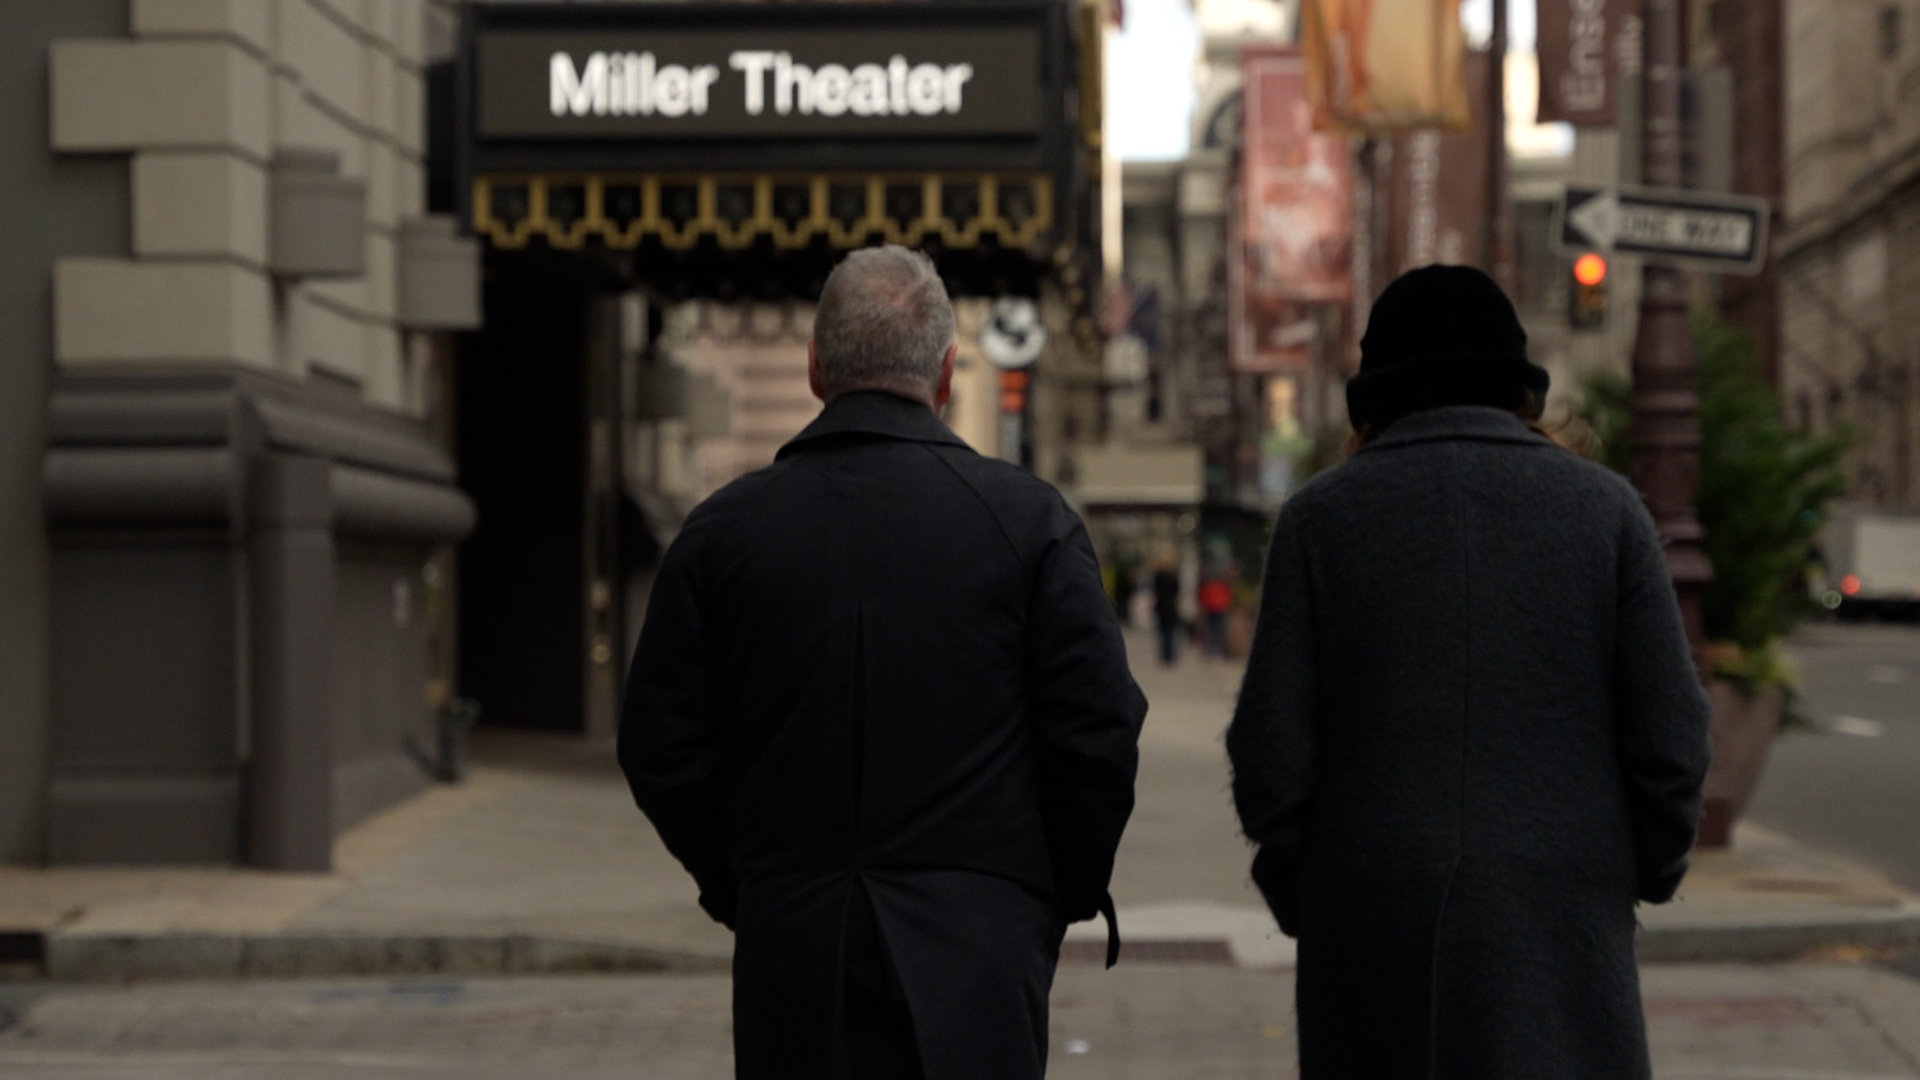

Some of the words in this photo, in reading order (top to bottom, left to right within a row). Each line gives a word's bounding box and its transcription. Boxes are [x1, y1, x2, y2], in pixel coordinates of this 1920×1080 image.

[550, 51, 719, 116] Miller
[729, 50, 973, 116] Theater
[1683, 214, 1747, 250] WAY
